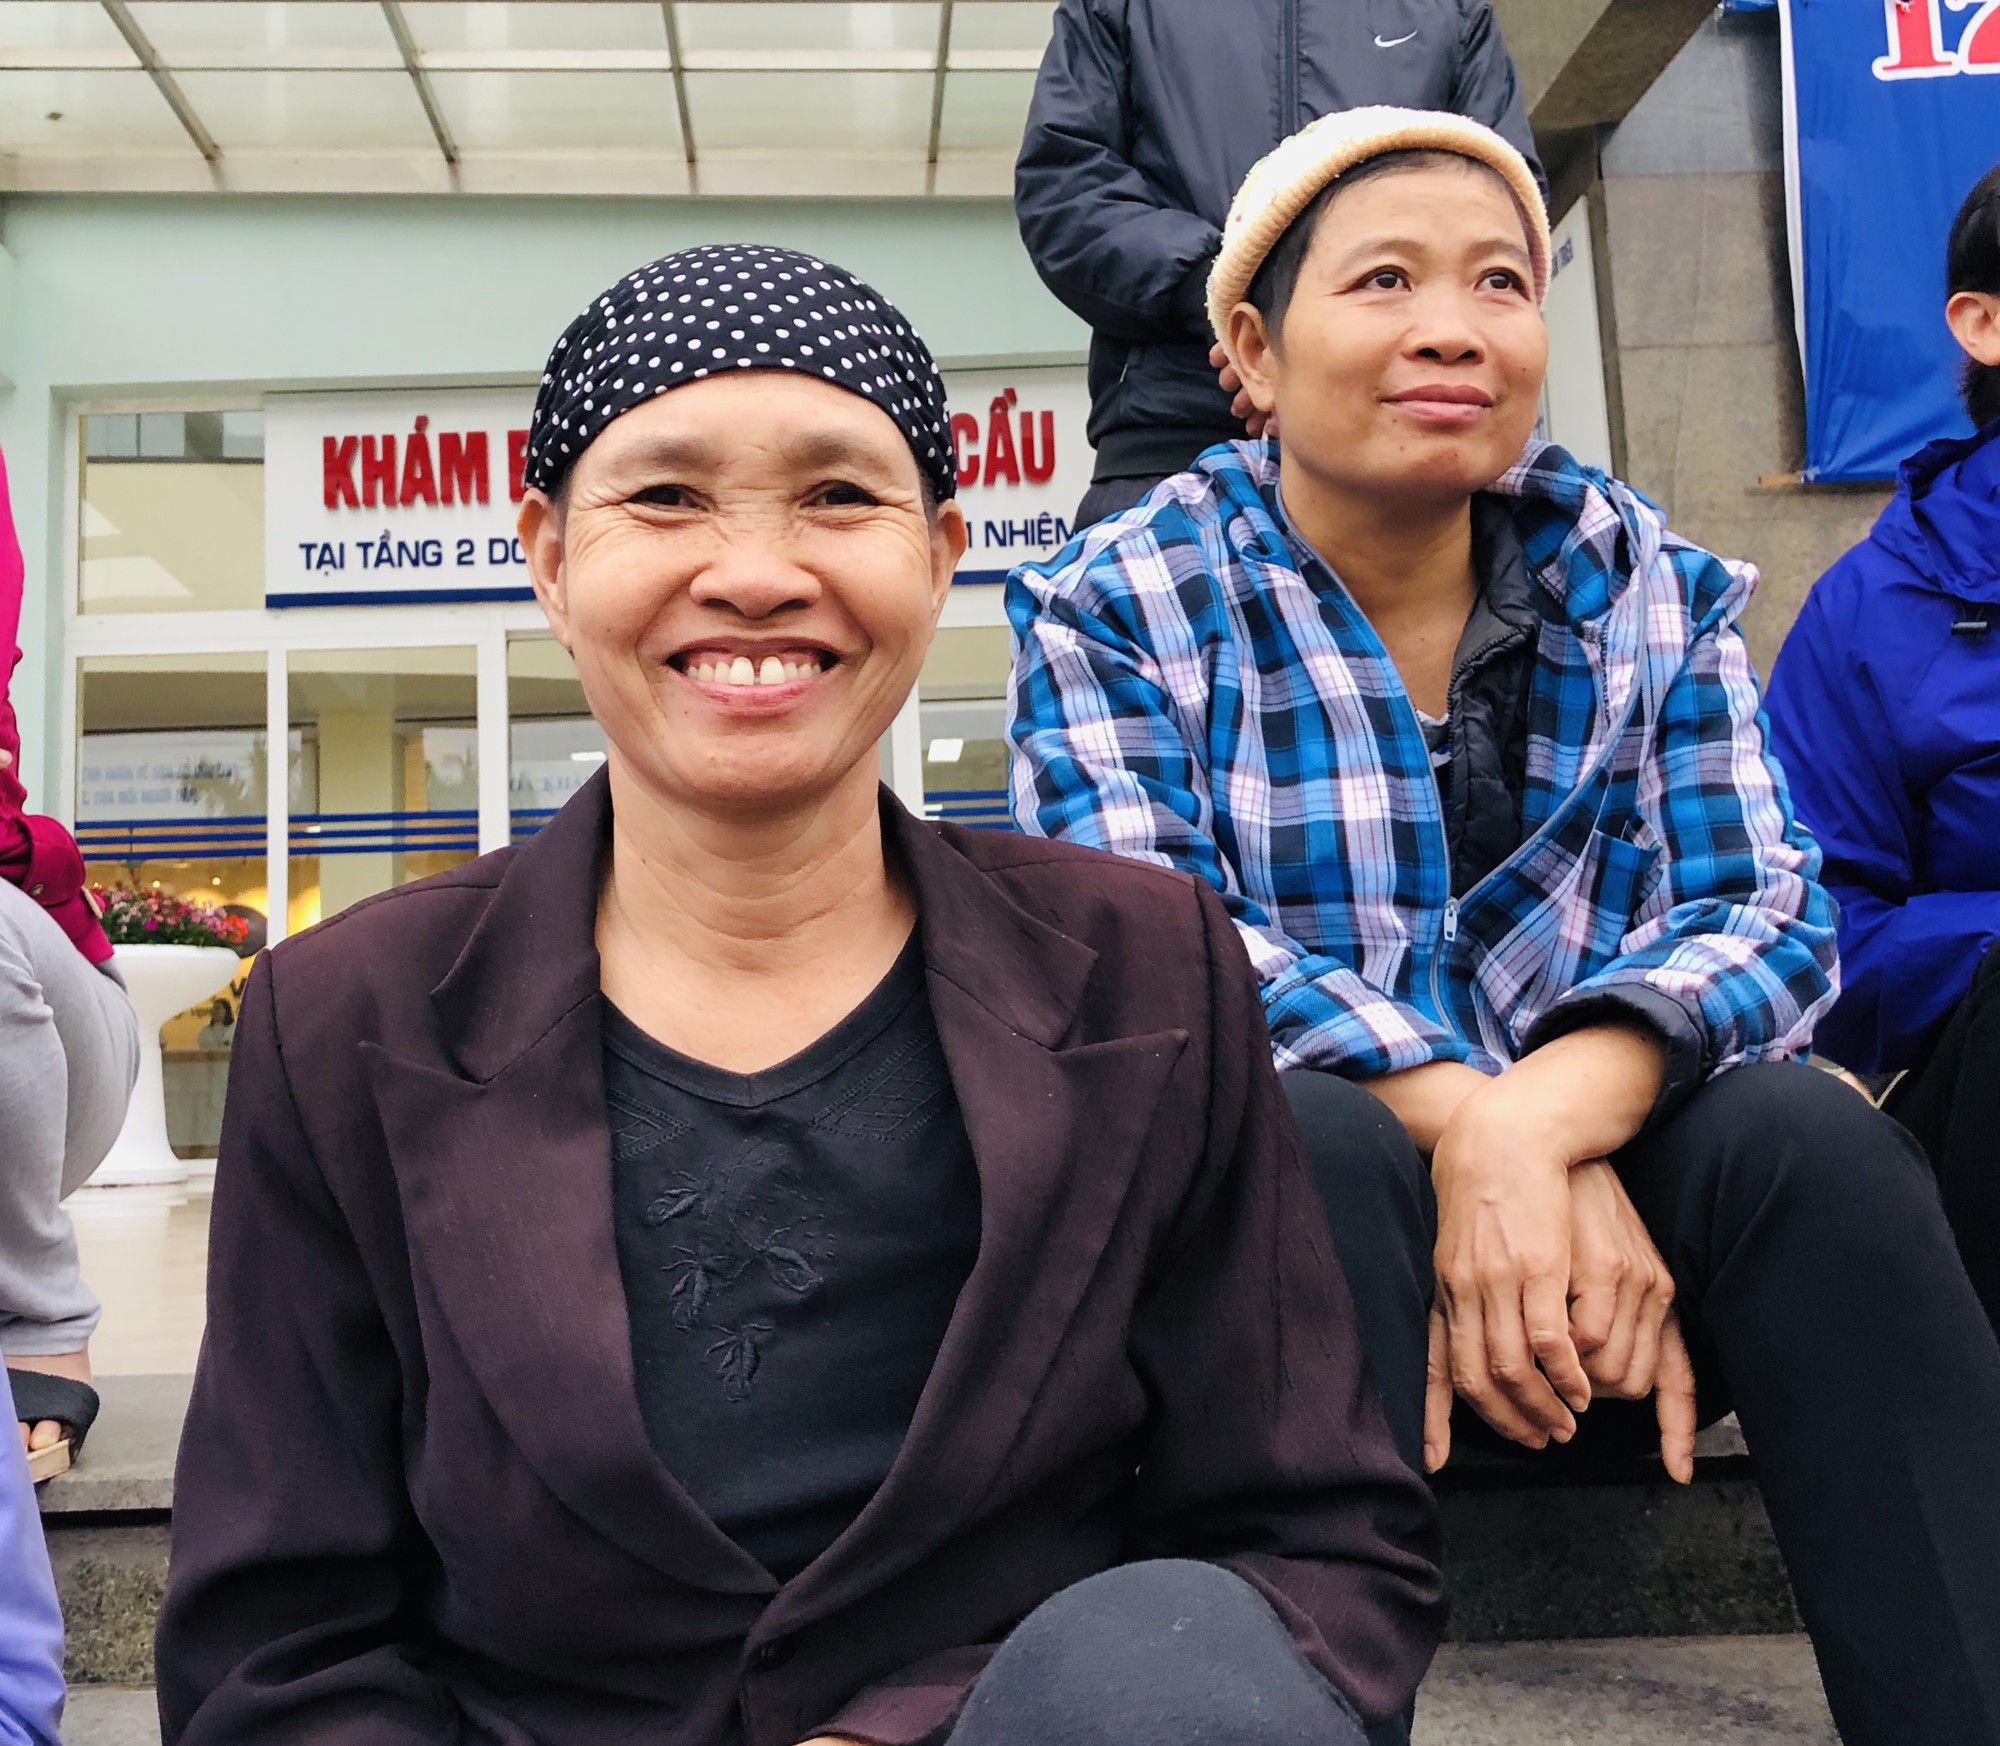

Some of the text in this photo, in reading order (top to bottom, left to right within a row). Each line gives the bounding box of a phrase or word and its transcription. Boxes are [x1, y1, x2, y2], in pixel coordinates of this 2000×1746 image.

[323, 415, 490, 509] KHÁM
[950, 388, 1056, 487] CẦU
[299, 542, 345, 576] TẠI
[356, 529, 443, 568] TẦNG
[456, 538, 475, 565] 2
[984, 511, 1075, 551] NHIỆM
